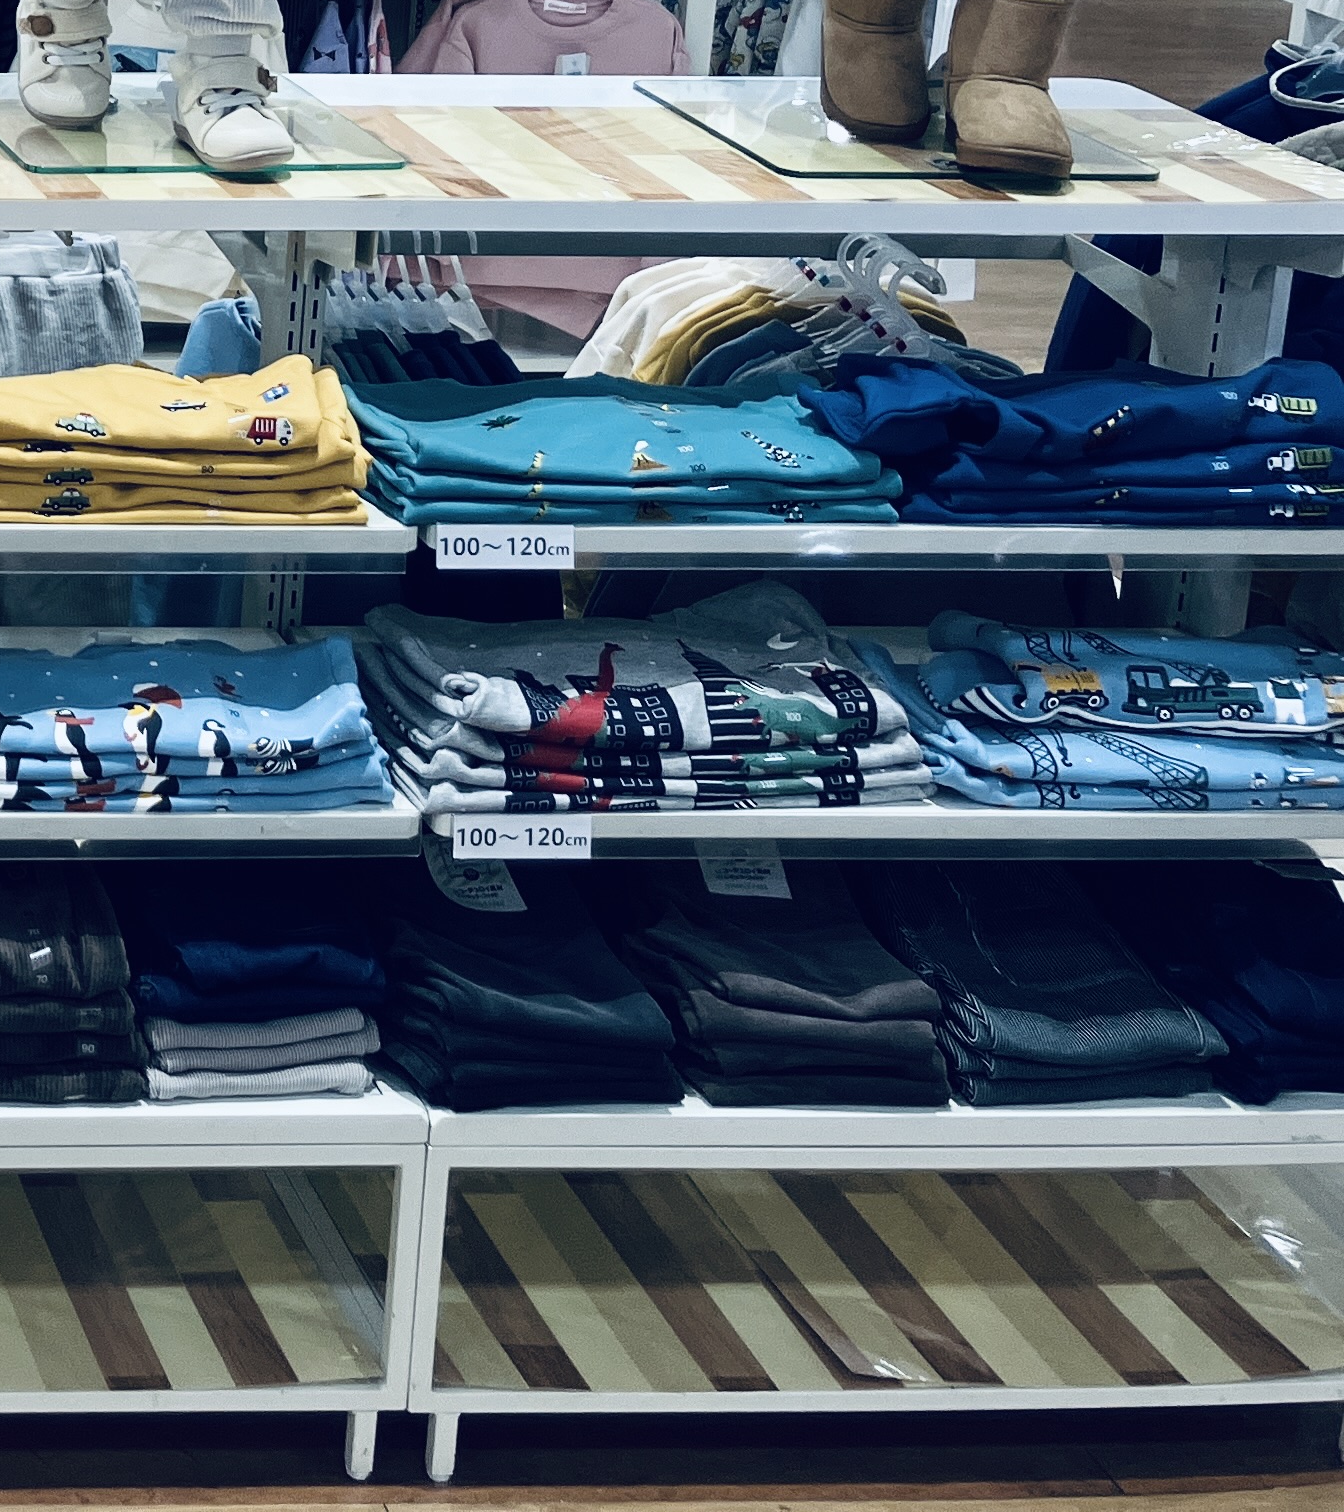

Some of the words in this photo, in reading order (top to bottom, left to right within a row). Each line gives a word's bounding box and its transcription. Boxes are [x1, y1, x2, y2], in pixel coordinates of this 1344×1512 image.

[689, 463, 707, 472] 100
[1211, 461, 1230, 471] 100
[36, 974, 48, 984] 70
[81, 1043, 95, 1054] 90
